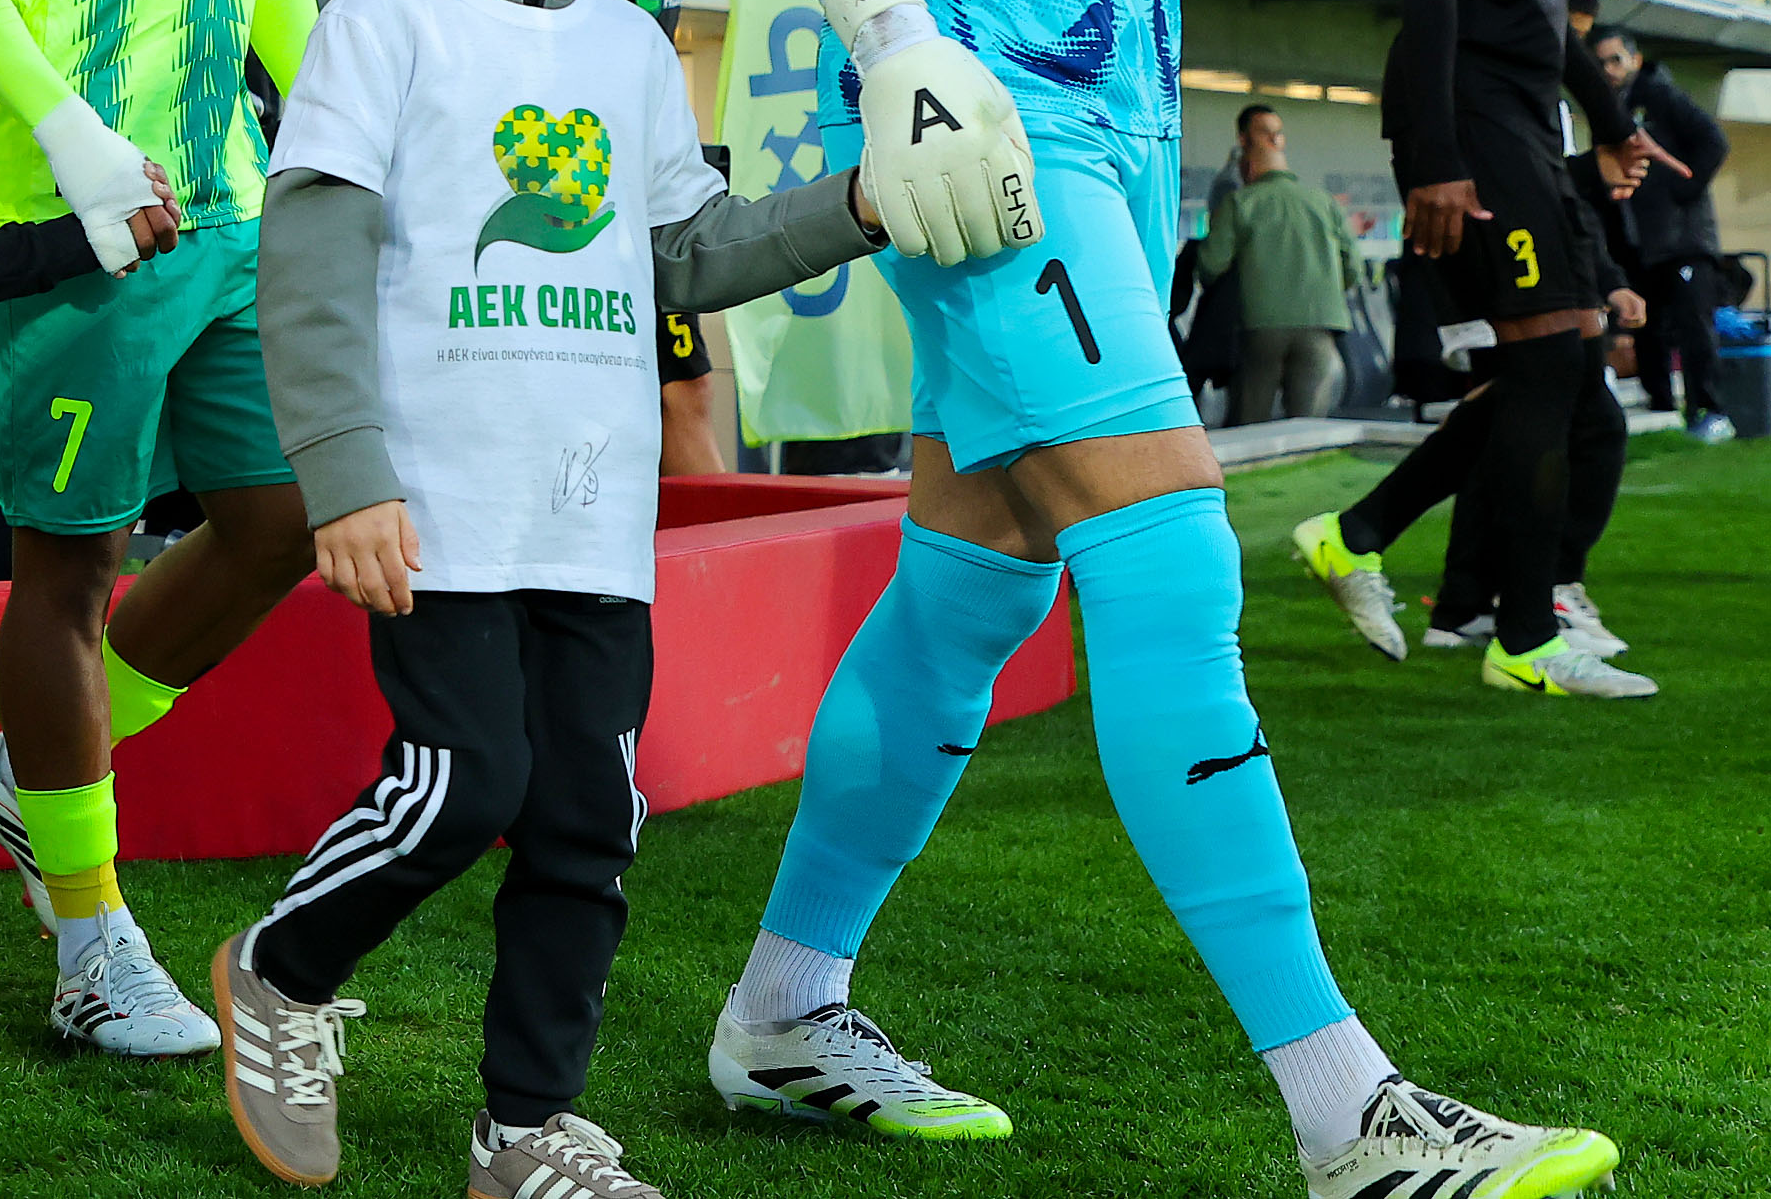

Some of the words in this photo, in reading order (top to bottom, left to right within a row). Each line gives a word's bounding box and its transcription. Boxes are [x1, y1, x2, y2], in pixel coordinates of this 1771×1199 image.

[911, 87, 964, 145] A
[1506, 228, 1541, 289] 3
[448, 285, 528, 329] AEK
[537, 284, 637, 335] CARES
[665, 314, 695, 358] 5
[1036, 258, 1101, 365] 1
[447, 348, 469, 362] ΑΕΚ
[50, 397, 93, 494] 7
